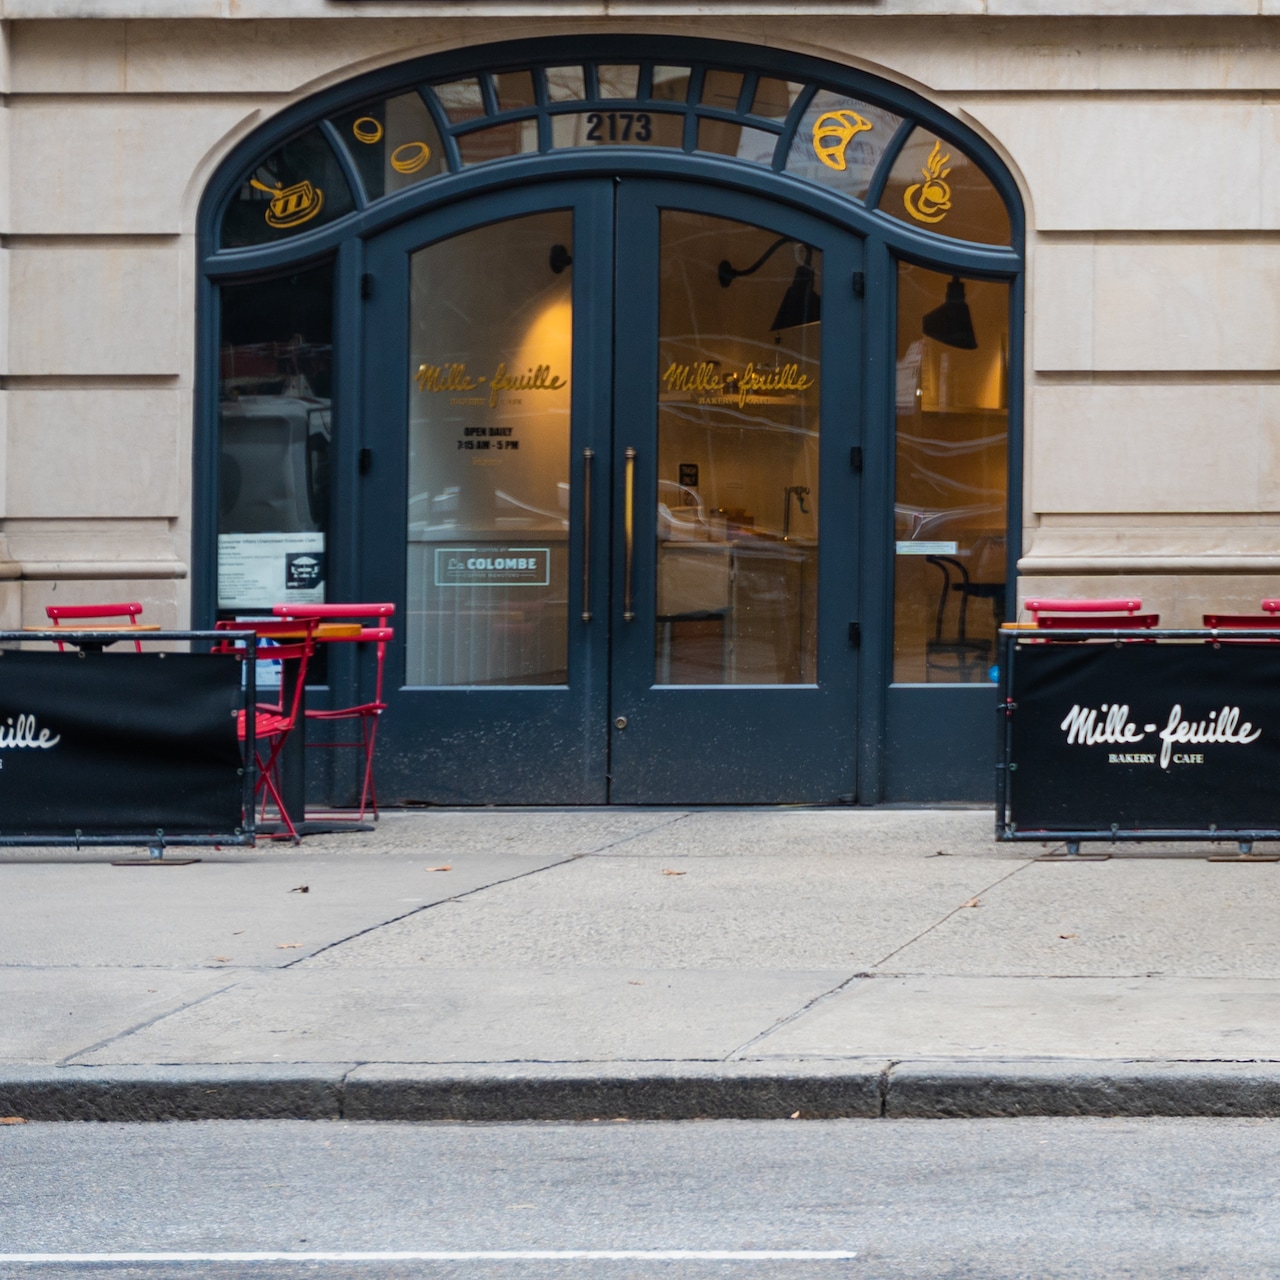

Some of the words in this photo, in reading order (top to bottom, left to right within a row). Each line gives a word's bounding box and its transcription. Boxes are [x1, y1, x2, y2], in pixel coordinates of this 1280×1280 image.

[586, 113, 652, 142] 2173
[463, 427, 487, 437] OPEN
[488, 427, 513, 437] DAILY
[475, 440, 490, 450] AM
[497, 440, 504, 450] 5
[505, 440, 519, 450] PM
[467, 558, 537, 570] COLOMBE
[1108, 754, 1157, 764] BAKERY
[1173, 754, 1204, 764] CAFE
